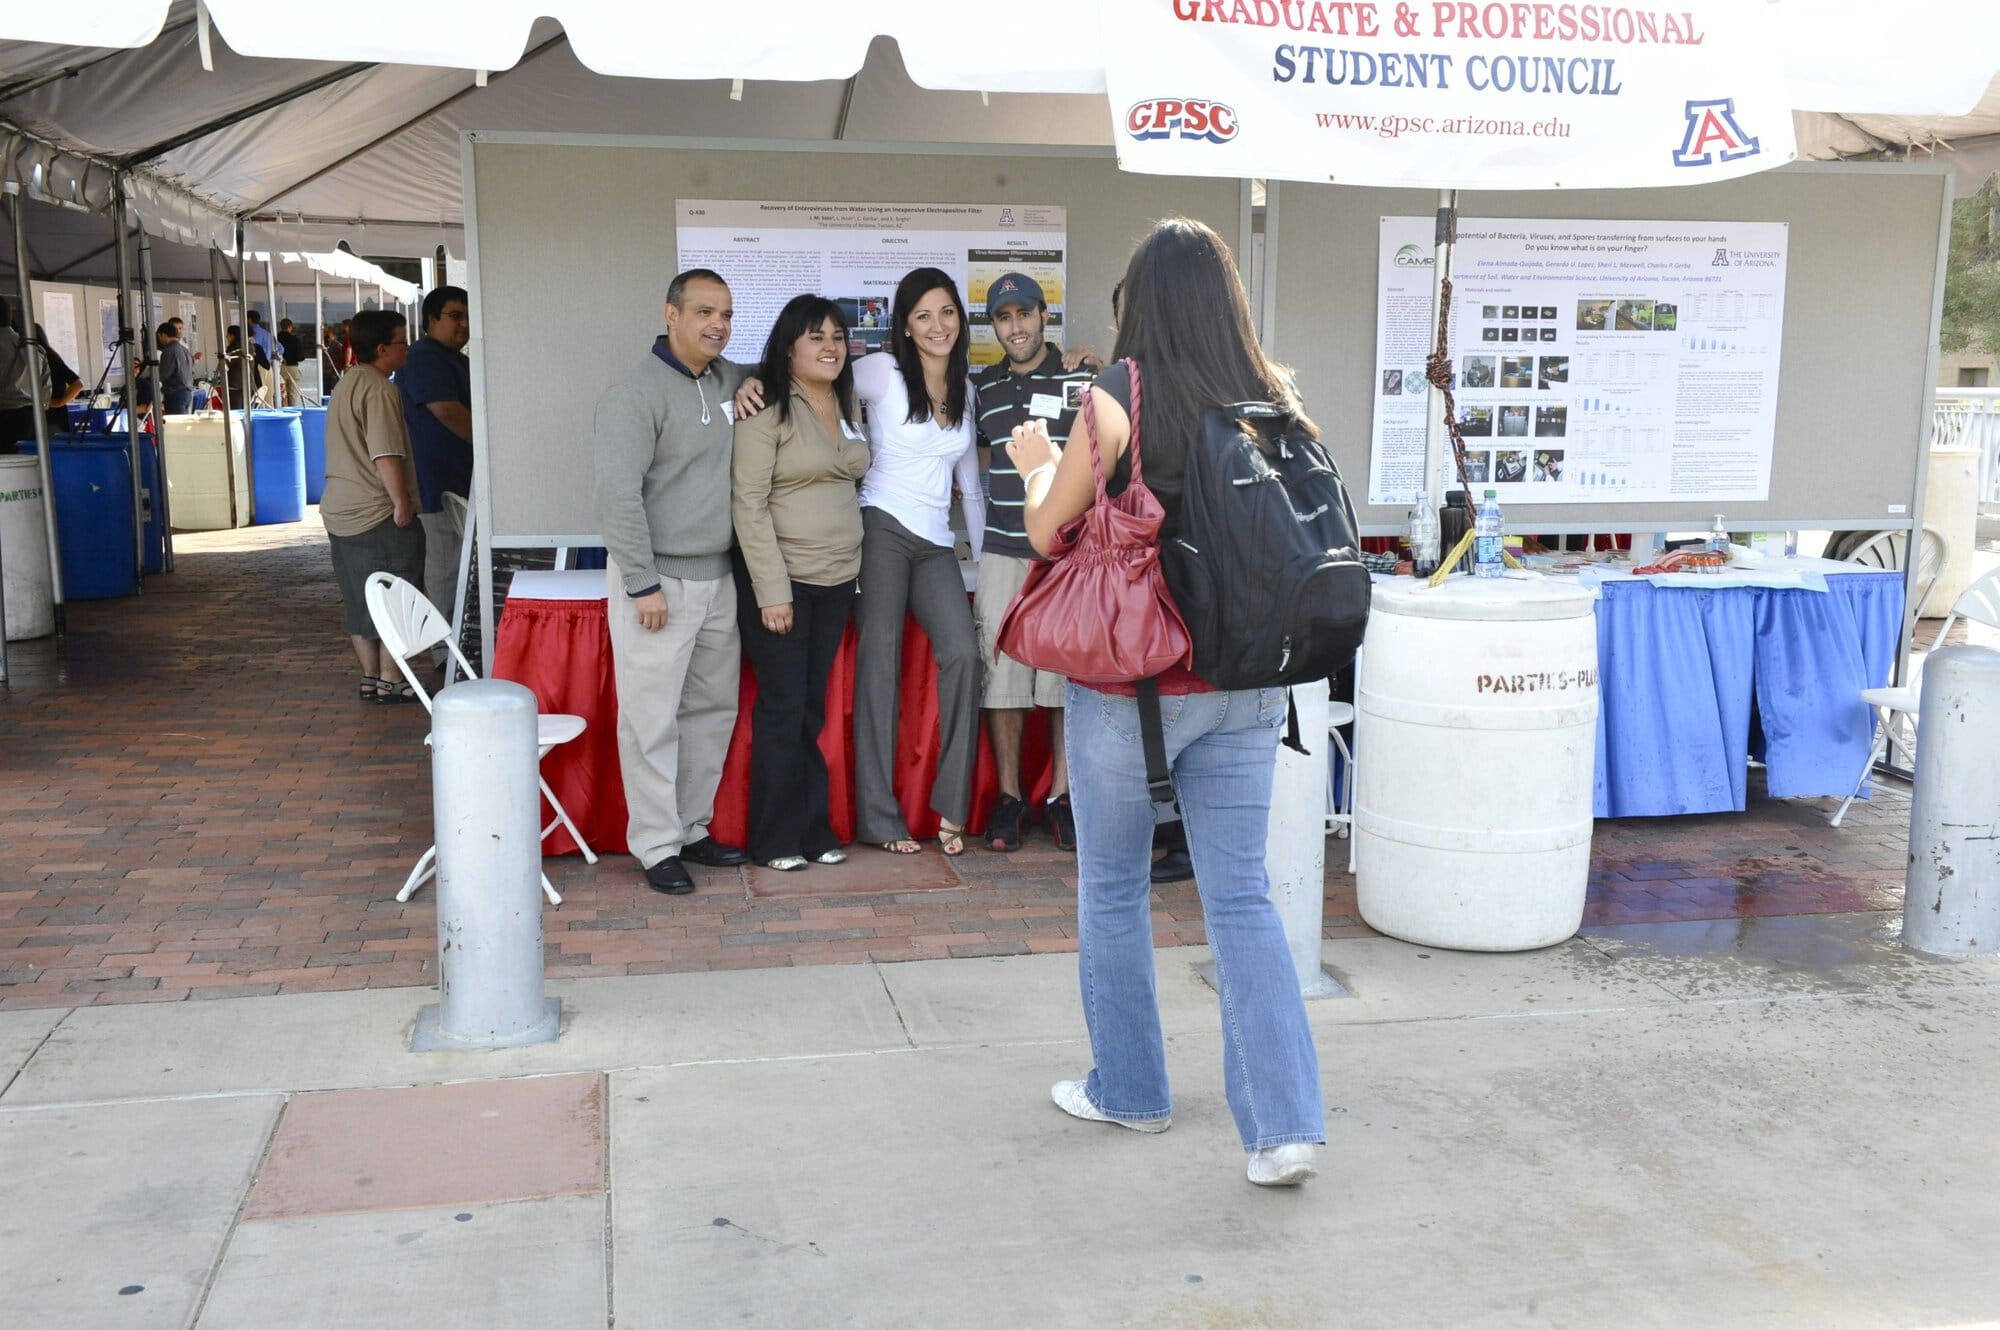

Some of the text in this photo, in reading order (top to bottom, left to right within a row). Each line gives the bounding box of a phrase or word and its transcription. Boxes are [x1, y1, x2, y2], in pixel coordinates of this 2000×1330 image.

[1172, 0, 1705, 45] GRADUATE & PROFESSIONAL
[1272, 43, 1623, 96] STUDENT COUNCIL
[1125, 98, 1239, 144] GPSC
[1315, 112, 1571, 139] www.gpsc.arizona.edu
[760, 204, 786, 212] Recovery
[1455, 231, 1487, 241] potential
[1489, 231, 1497, 240] of
[1497, 232, 1528, 241] Bacteria,
[1530, 232, 1556, 241] Viruses,
[1558, 233, 1571, 241] and
[1573, 233, 1596, 243] Spores
[1597, 233, 1636, 243] transferring
[1637, 233, 1654, 242] from
[1655, 234, 1683, 242] surfaces
[1692, 236, 1707, 244] your
[1708, 235, 1727, 243] hands
[1525, 243, 1535, 251] Do
[1550, 244, 1571, 252] know
[1624, 245, 1648, 254] finger?
[1730, 251, 1781, 259] THE UNIVERSITY
[1599, 275, 1628, 283] University
[1629, 275, 1636, 283] of
